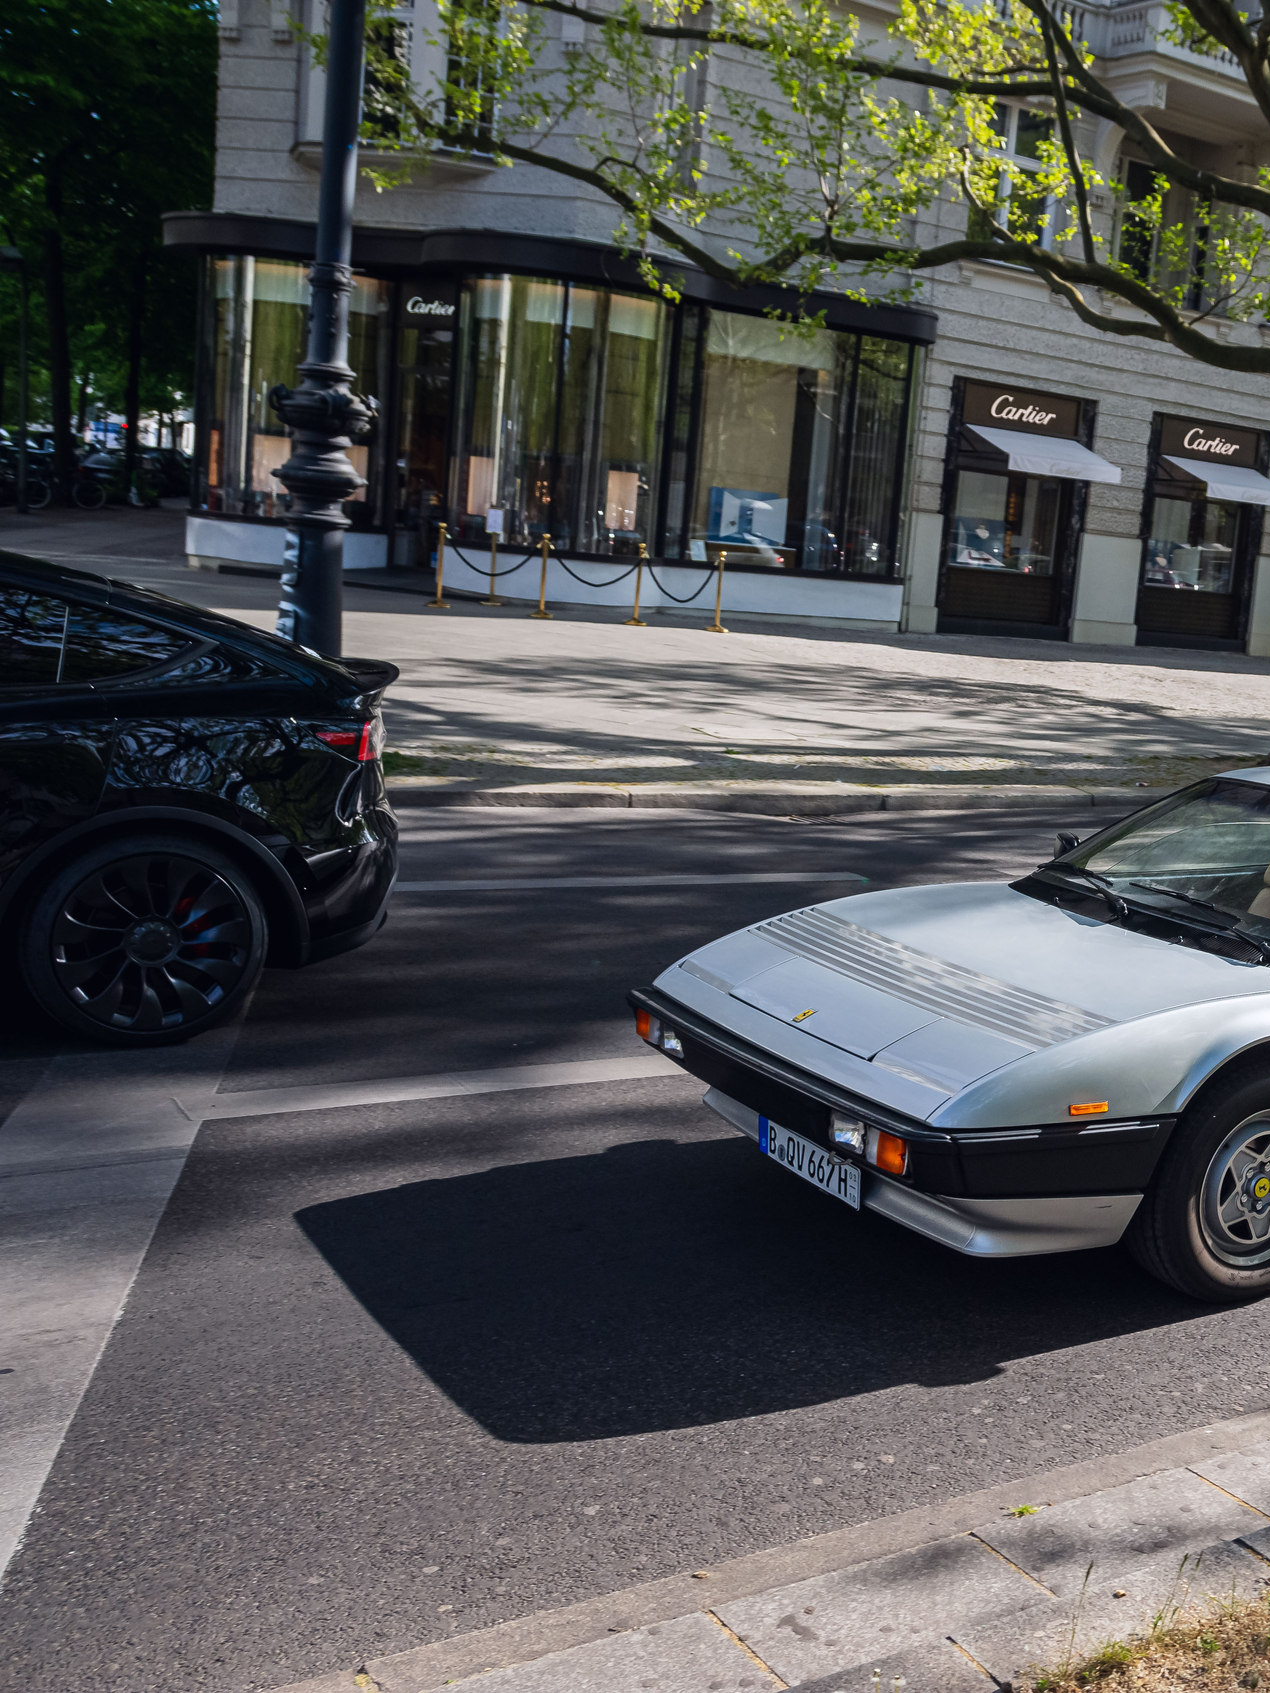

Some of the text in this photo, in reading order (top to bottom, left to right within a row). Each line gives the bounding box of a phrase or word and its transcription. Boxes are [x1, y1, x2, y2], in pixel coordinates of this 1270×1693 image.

[406, 296, 456, 316] Cartier
[990, 394, 1057, 425] Cartier
[1183, 427, 1240, 456] Cartier
[769, 1125, 777, 1155] B
[786, 1136, 806, 1172] QV
